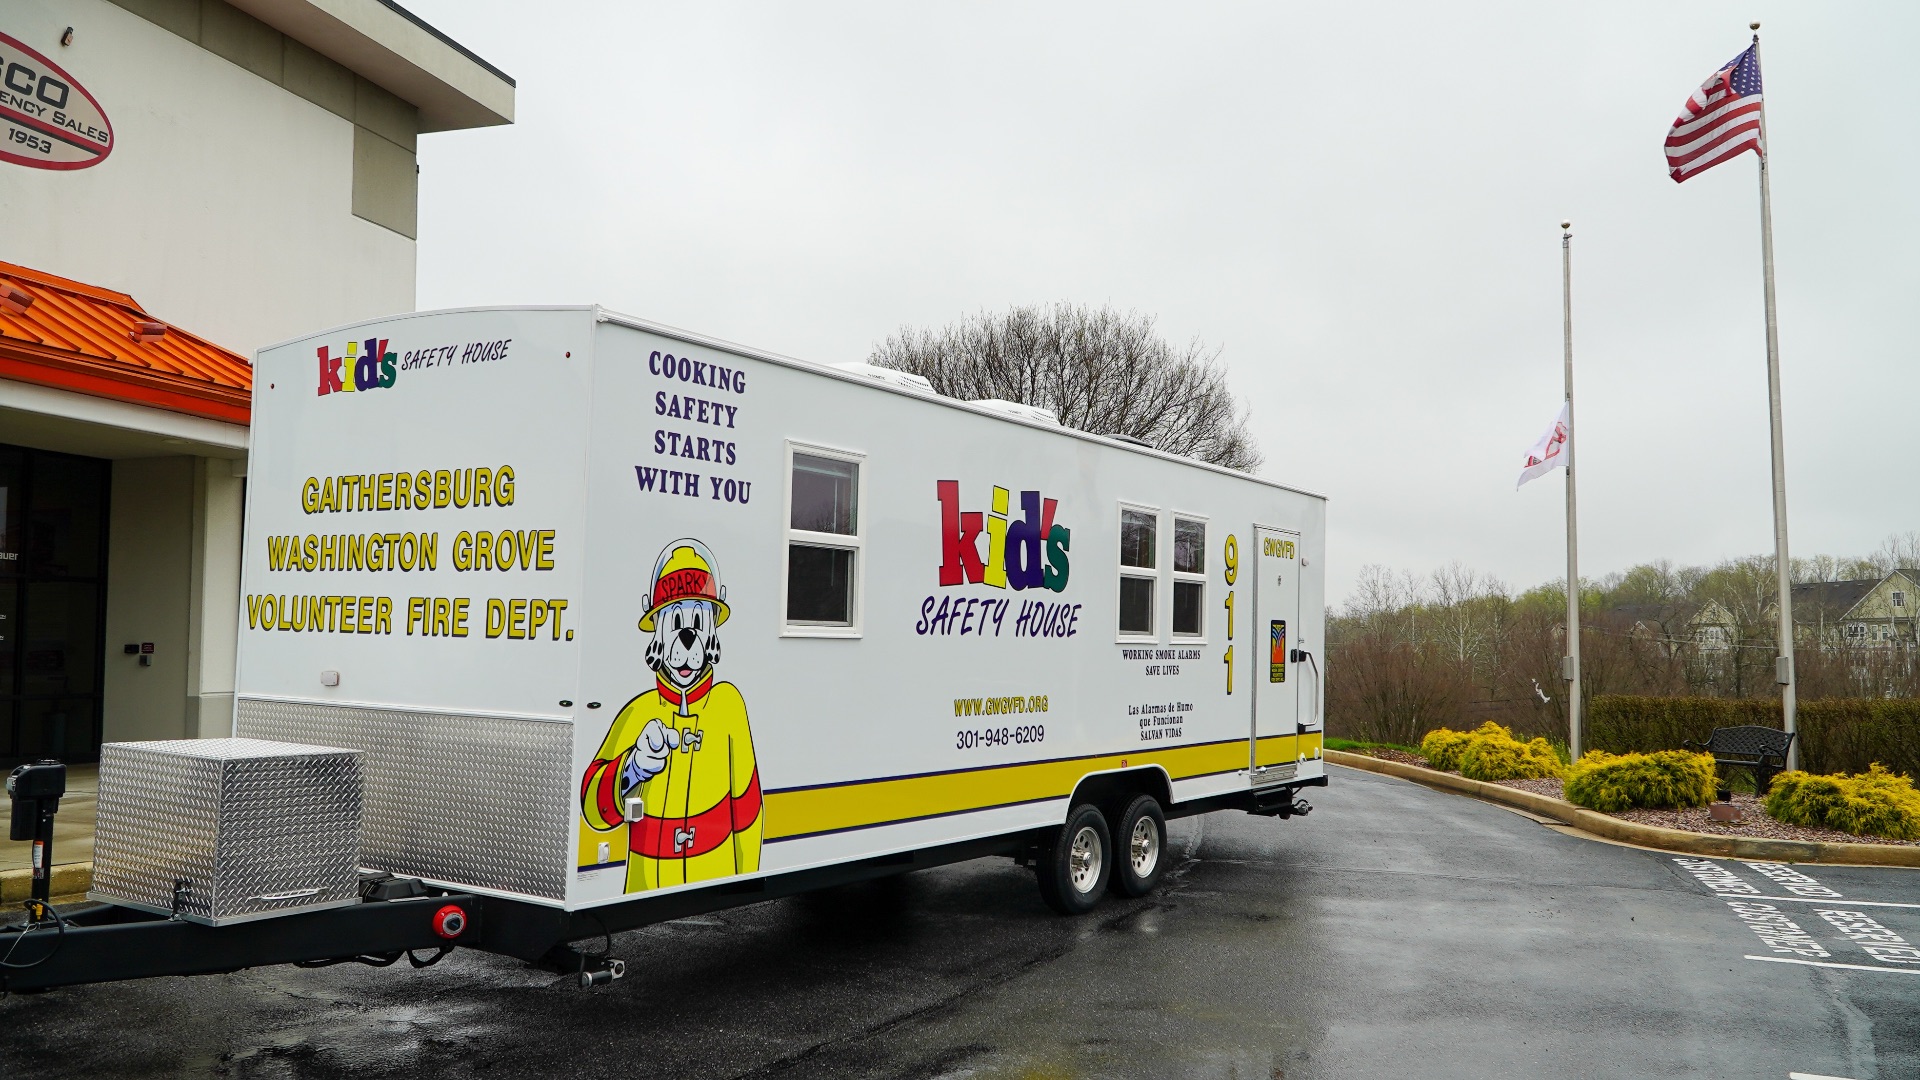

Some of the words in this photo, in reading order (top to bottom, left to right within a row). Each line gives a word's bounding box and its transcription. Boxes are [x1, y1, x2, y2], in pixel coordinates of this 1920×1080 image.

[0, 56, 70, 110] CO
[8, 127, 52, 154] 1953
[52, 110, 109, 143] SALES
[317, 337, 398, 397] kid's
[401, 345, 459, 371] SAFETY
[461, 339, 512, 365] HOUSE
[649, 350, 746, 394] COOKING
[655, 391, 738, 429] SAFETY
[654, 429, 736, 466] STARTS
[302, 464, 515, 515] GAITHERSBURG
[634, 465, 700, 498] WITH
[710, 476, 752, 505] YOU
[267, 531, 438, 573] WASHINGTON
[452, 529, 556, 573] GROVE
[937, 479, 1071, 593] kid's
[1263, 536, 1295, 560] GWGVFD
[661, 571, 713, 603] SPARKY
[246, 593, 393, 635] VOLUNTEER
[406, 596, 471, 638] FIRE
[485, 597, 575, 642] DEPT.
[915, 595, 1010, 637] SAFETY
[1015, 599, 1083, 638] HOUSE
[1122, 649, 1154, 661] WORKING
[1155, 649, 1176, 660] SMOKE
[1177, 650, 1201, 660] ALARMS
[1145, 665, 1161, 676] SAVE
[1162, 665, 1180, 676] LIVES
[953, 694, 1049, 717] WWW.GWGVFD.ORG
[1128, 704, 1140, 716] Las
[1140, 703, 1167, 715] Alarmas
[1168, 702, 1175, 713] de
[1176, 701, 1194, 712] Humo
[1139, 718, 1151, 730] que
[956, 724, 1045, 750] 301-948-6209
[1140, 728, 1163, 741] SALVAN
[1164, 727, 1183, 739] VIDAS
[1725, 901, 1832, 957] CUSTOMER
